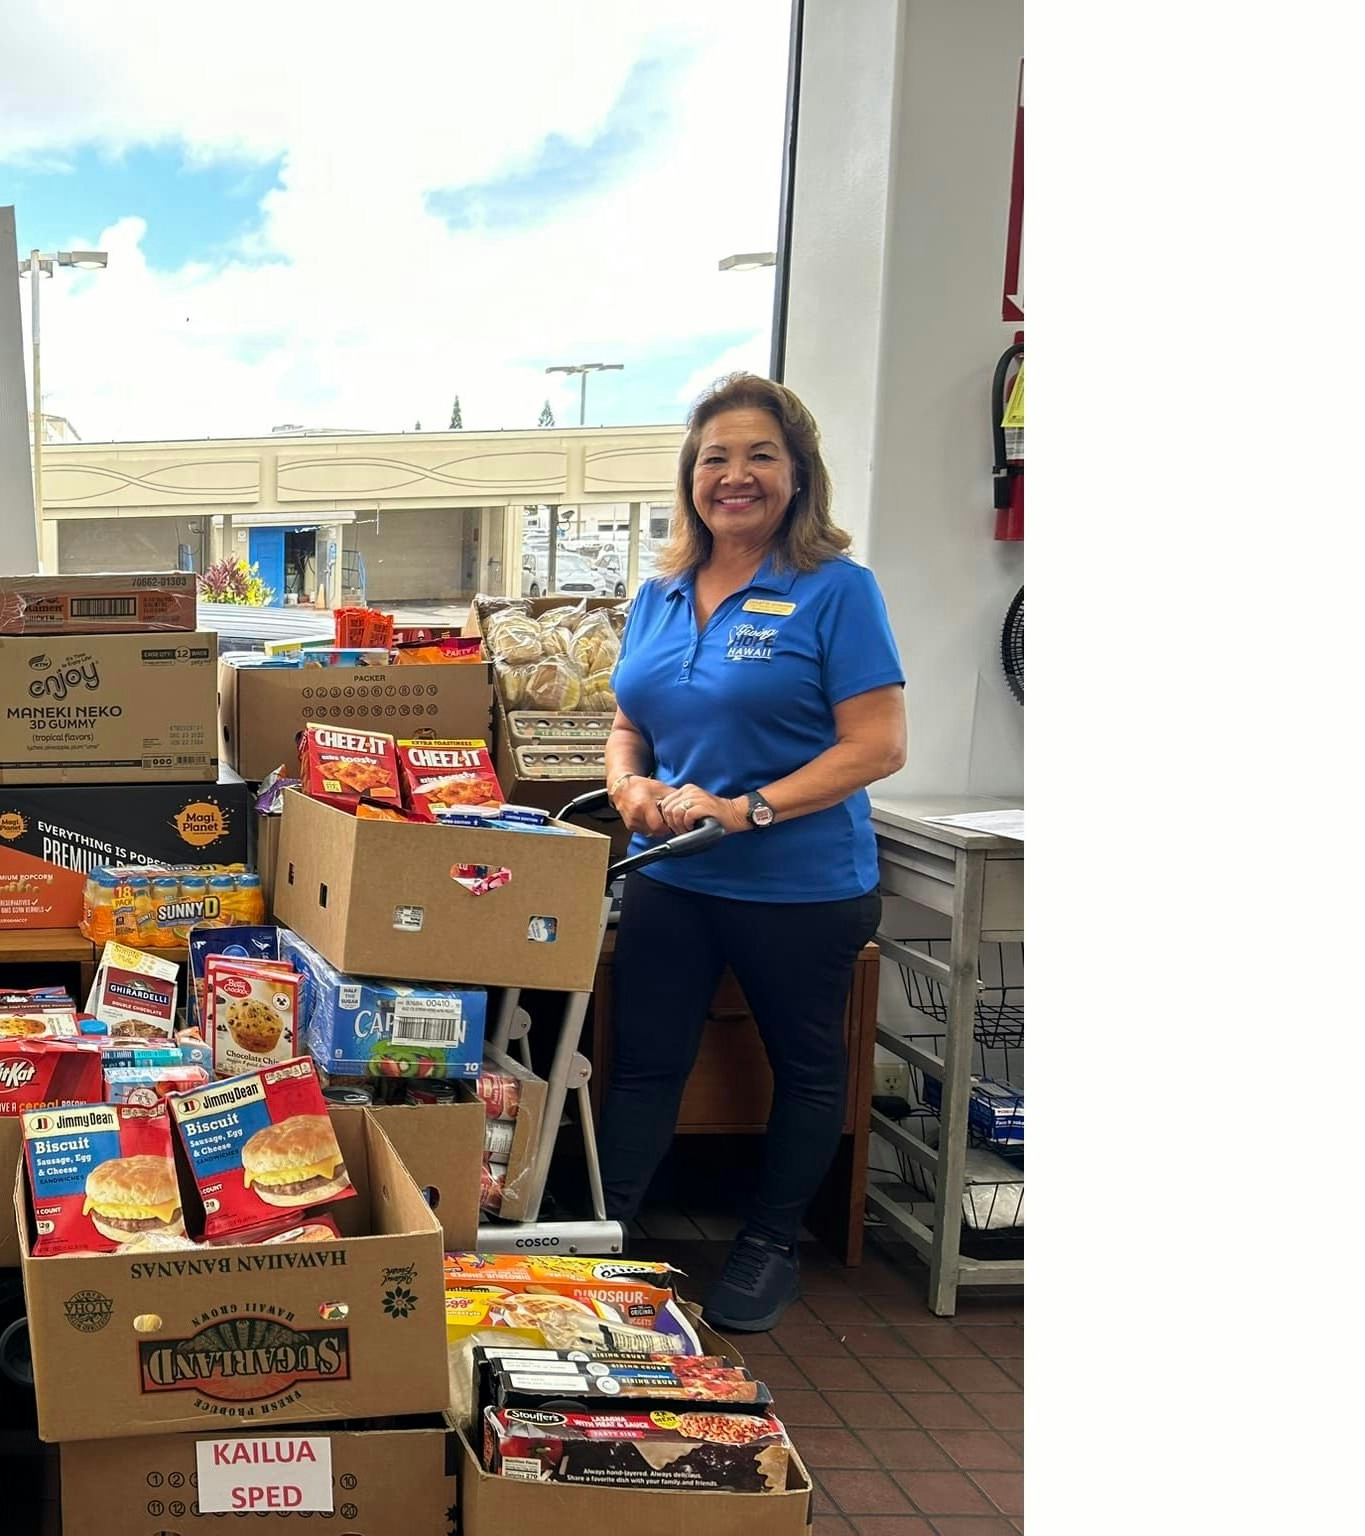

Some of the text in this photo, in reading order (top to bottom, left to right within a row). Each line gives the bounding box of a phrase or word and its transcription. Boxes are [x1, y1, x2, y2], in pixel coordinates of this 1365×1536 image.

[176, 649, 189, 658] 12
[727, 648, 772, 657] HAWAII
[29, 661, 101, 700] enjoy
[354, 674, 387, 682] PACKER
[7, 705, 122, 718] MANEKI NEKO
[29, 719, 97, 729] 3D GUMMY
[185, 812, 216, 825] Magi
[183, 821, 219, 832] Planet
[37, 821, 127, 858] EVERYTHING IS
[20, 873, 54, 881] POPCORN
[115, 885, 132, 898] 18
[115, 899, 134, 907] PACK
[110, 984, 168, 1004] GHIRARDELLI
[111, 1000, 163, 1016] DOUBLE CHOCOLATE
[426, 1000, 450, 1008] 00410
[226, 1049, 262, 1063] Chocolate
[464, 1062, 479, 1072] 10
[12, 1102, 17, 1112] A
[185, 1112, 240, 1136] Biscuit
[189, 1128, 243, 1148] Sausage, Egg
[34, 1137, 90, 1154] Biscuit
[201, 1143, 232, 1155] Cheese
[36, 1154, 92, 1167] Sausage, Egg
[38, 1166, 78, 1177] & Cheese
[39, 1175, 84, 1185] SANDWICHES
[202, 1183, 223, 1194] COUNT
[40, 1206, 62, 1215] COUNT
[515, 1235, 560, 1249] COSCO
[130, 1250, 348, 1280] HAWAIIAN BANANAS
[63, 1301, 113, 1315] ALOHA
[192, 1303, 296, 1328] HAWAII GROWN
[148, 1337, 340, 1385] SUGARLAND
[192, 1390, 303, 1418] FRESH PRODUCE
[511, 1409, 560, 1422] Stouffer's
[590, 1415, 626, 1423] LASAGNA
[213, 1440, 317, 1466] KAILUA
[583, 1468, 702, 1479] Always hand-layered. Always delicious.
[661, 1478, 679, 1486] family
[231, 1486, 303, 1509] SPED
